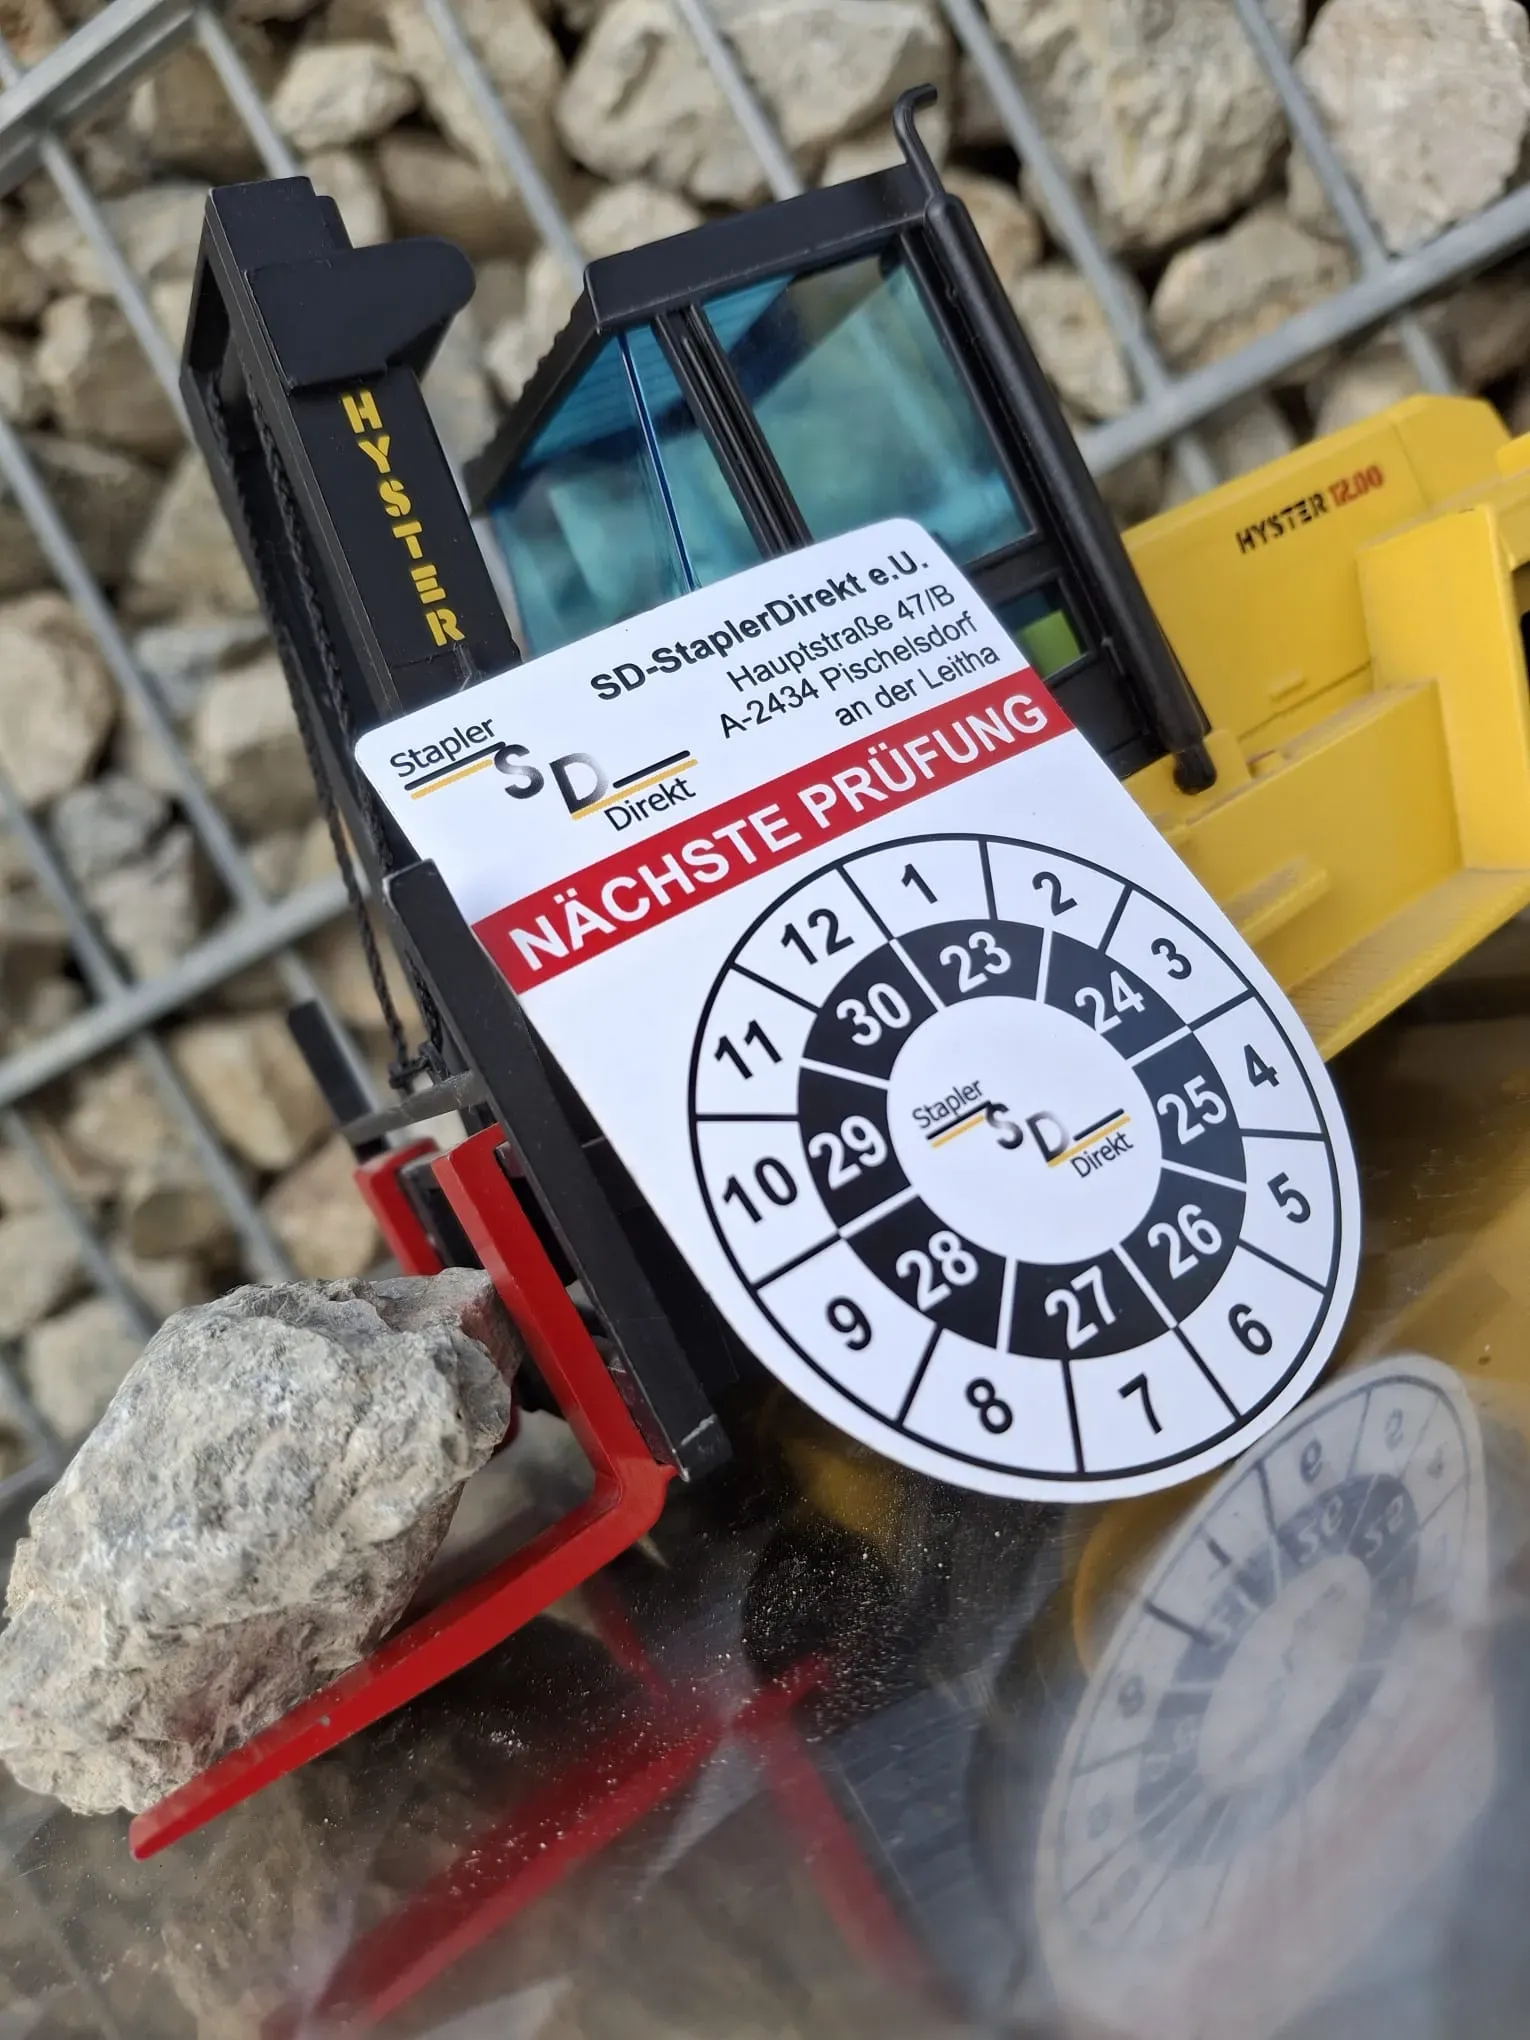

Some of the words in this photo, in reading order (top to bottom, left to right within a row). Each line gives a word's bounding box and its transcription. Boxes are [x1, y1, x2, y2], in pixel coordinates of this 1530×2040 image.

[341, 390, 466, 647] HYSTER
[1235, 493, 1328, 554] HYSTER
[590, 572, 867, 701] SD-StaplerDirekt
[868, 550, 930, 587] e.U.
[727, 613, 893, 692] Hauptstraße
[898, 583, 956, 621] 47/B
[720, 678, 819, 739] A-2434
[820, 610, 978, 692] Pischelsdorf
[835, 698, 873, 728] an
[875, 677, 917, 710] der
[918, 643, 1001, 690] Leitha
[390, 718, 496, 778] Stapler
[509, 803, 804, 972] NÄCHSTE
[798, 692, 1049, 831] PRÜFUNG
[603, 777, 697, 832] Direkt
[900, 863, 938, 904] 1
[1032, 872, 1076, 916] 2
[781, 908, 854, 966] 12
[939, 931, 1012, 993] 23
[1150, 938, 1192, 980] 3
[835, 981, 912, 1047] 30
[1074, 970, 1146, 1032] 24
[714, 1020, 783, 1082] 11
[1245, 1043, 1279, 1089] 4
[912, 1080, 983, 1129] Stapler
[1157, 1075, 1227, 1145] 25
[808, 1115, 888, 1188] 29
[1070, 1132, 1134, 1179] Direkt
[723, 1156, 796, 1223] 10
[1267, 1173, 1311, 1224] 5
[896, 1230, 979, 1311] 28
[1147, 1203, 1223, 1279] 26
[826, 1295, 873, 1351] 9
[1045, 1264, 1117, 1350] 27
[1228, 1304, 1273, 1356] 6
[965, 1378, 1014, 1434] 8
[1118, 1373, 1164, 1434] 7
